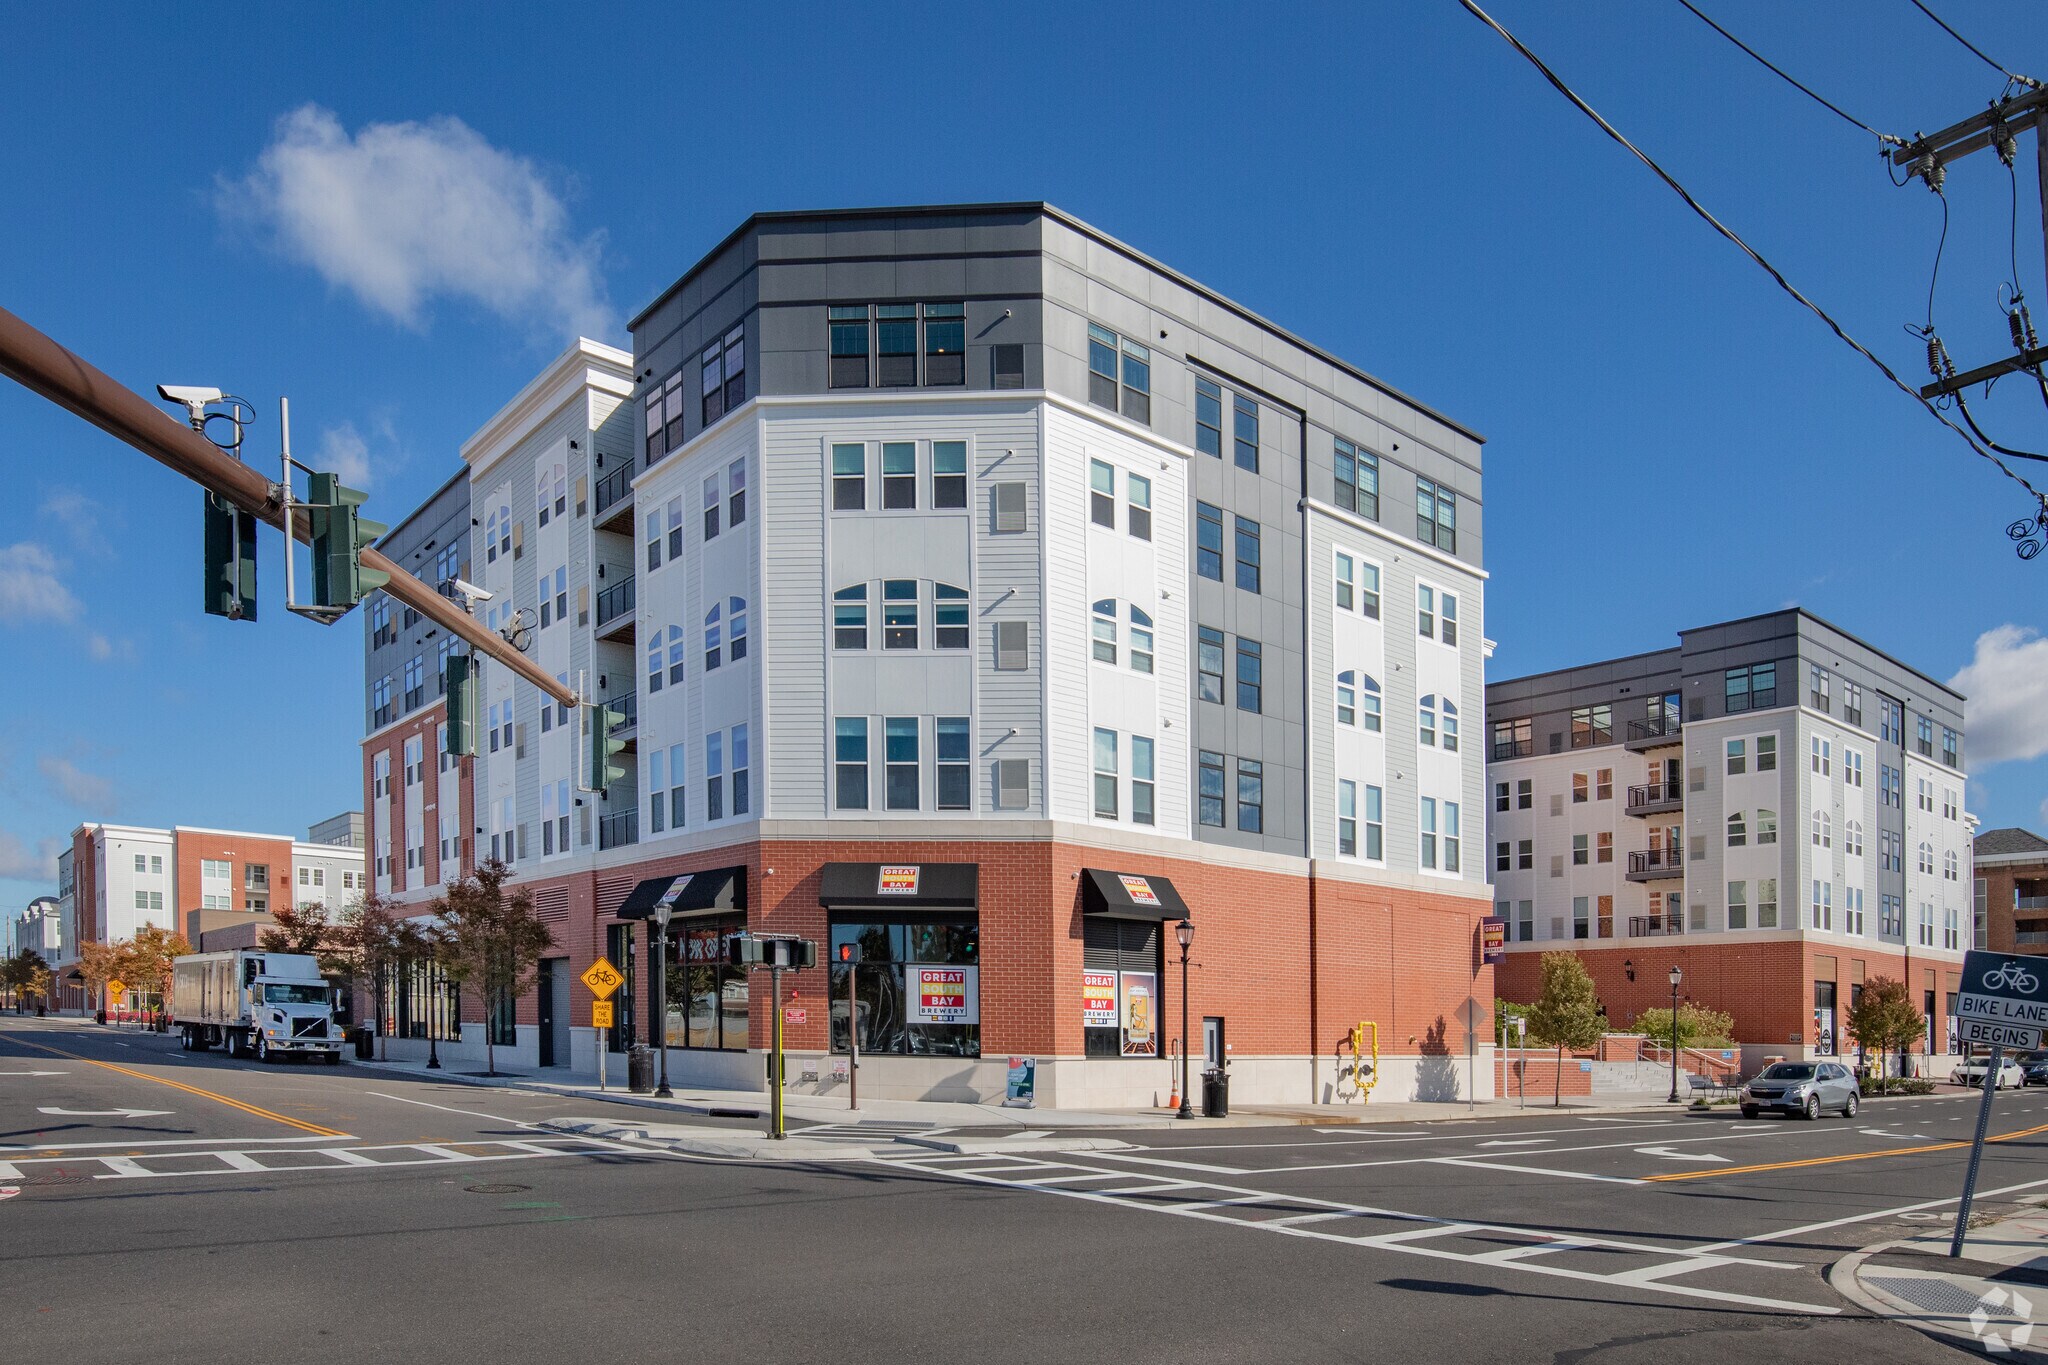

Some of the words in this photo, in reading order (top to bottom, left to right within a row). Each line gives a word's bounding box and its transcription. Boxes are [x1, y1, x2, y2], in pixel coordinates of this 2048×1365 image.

[1485, 925, 1503, 933] GREAT
[923, 972, 962, 982] GREAT
[1085, 976, 1113, 986] GREAT
[923, 985, 963, 994] SOUTH
[1085, 988, 1113, 997] SOUTH
[931, 996, 954, 1005] BAY
[1091, 1000, 1108, 1008] BAY
[1963, 997, 2000, 1015] BIKE
[2004, 1002, 2048, 1022] LANE
[1970, 1024, 2030, 1046] BEGINS
